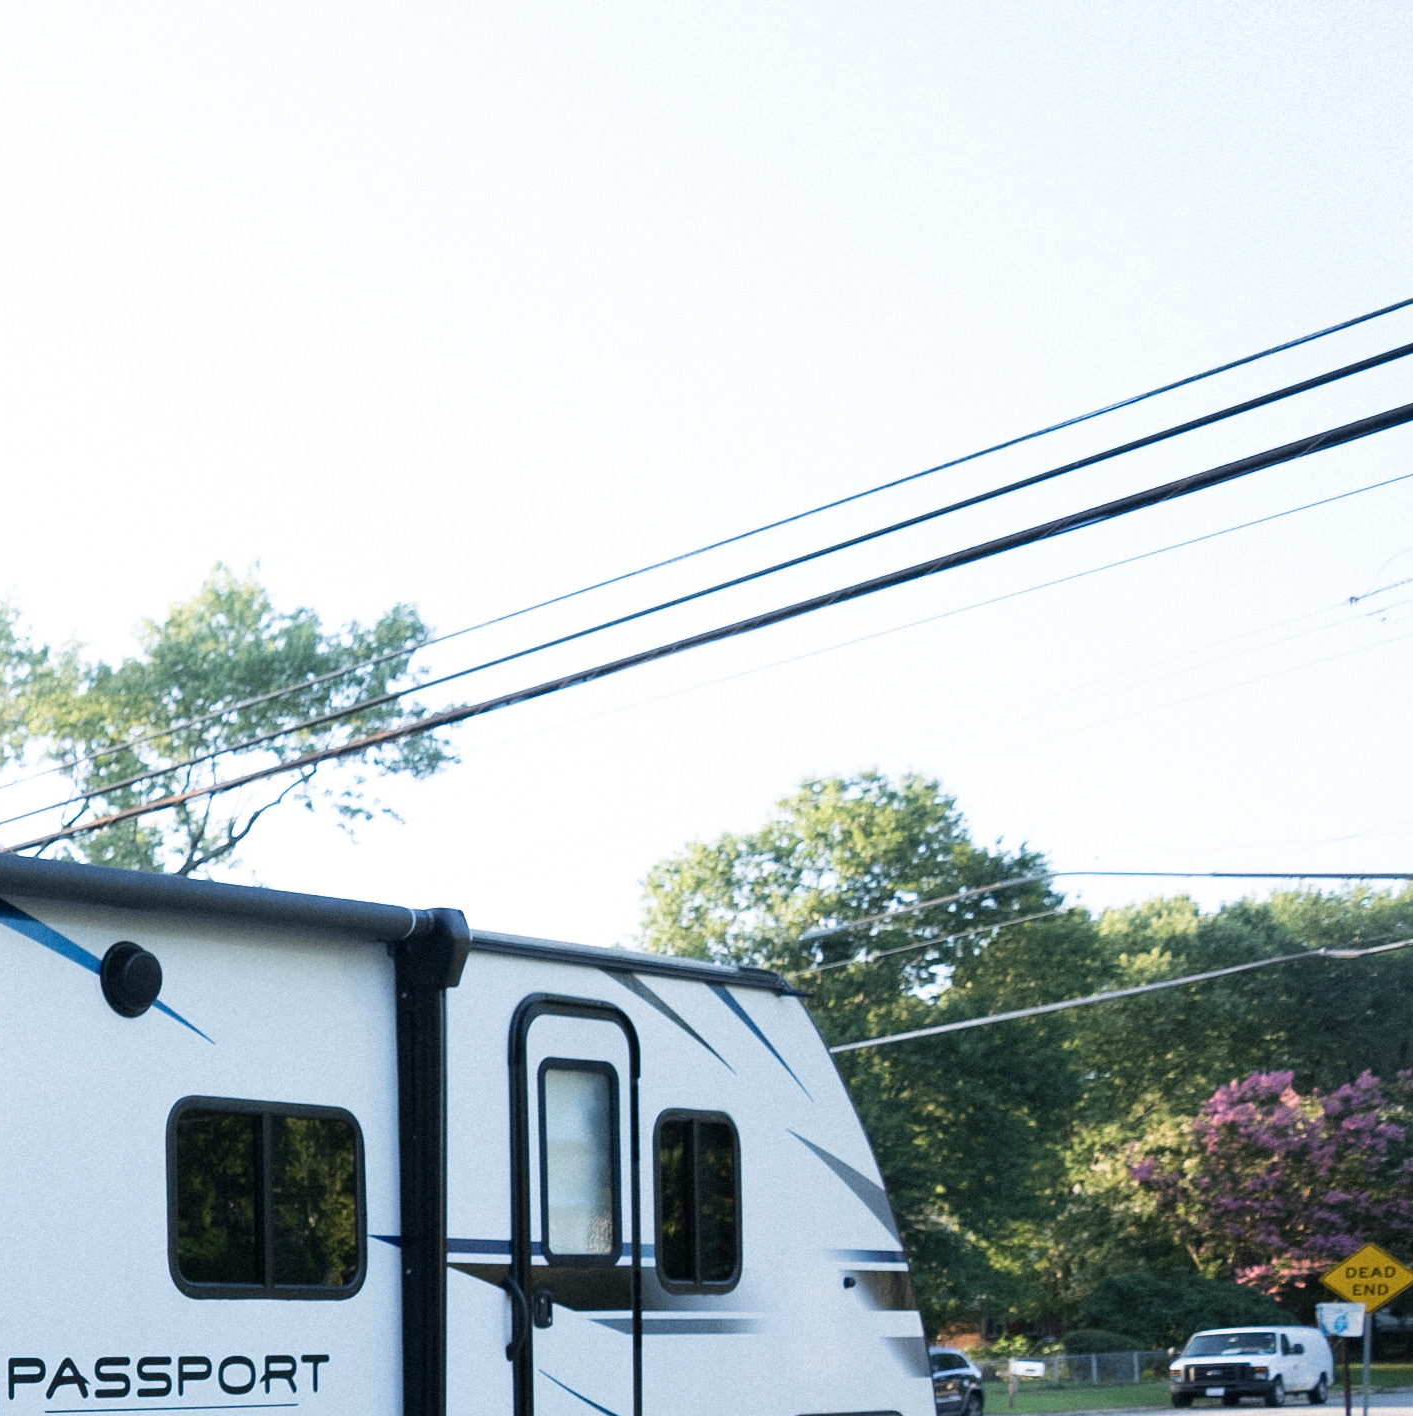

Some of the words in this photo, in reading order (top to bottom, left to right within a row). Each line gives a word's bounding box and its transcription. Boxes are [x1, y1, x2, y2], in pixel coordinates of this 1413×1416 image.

[1345, 1266, 1396, 1279] DEAD
[1352, 1283, 1389, 1296] END
[7, 1354, 330, 1400] PASSPORT
